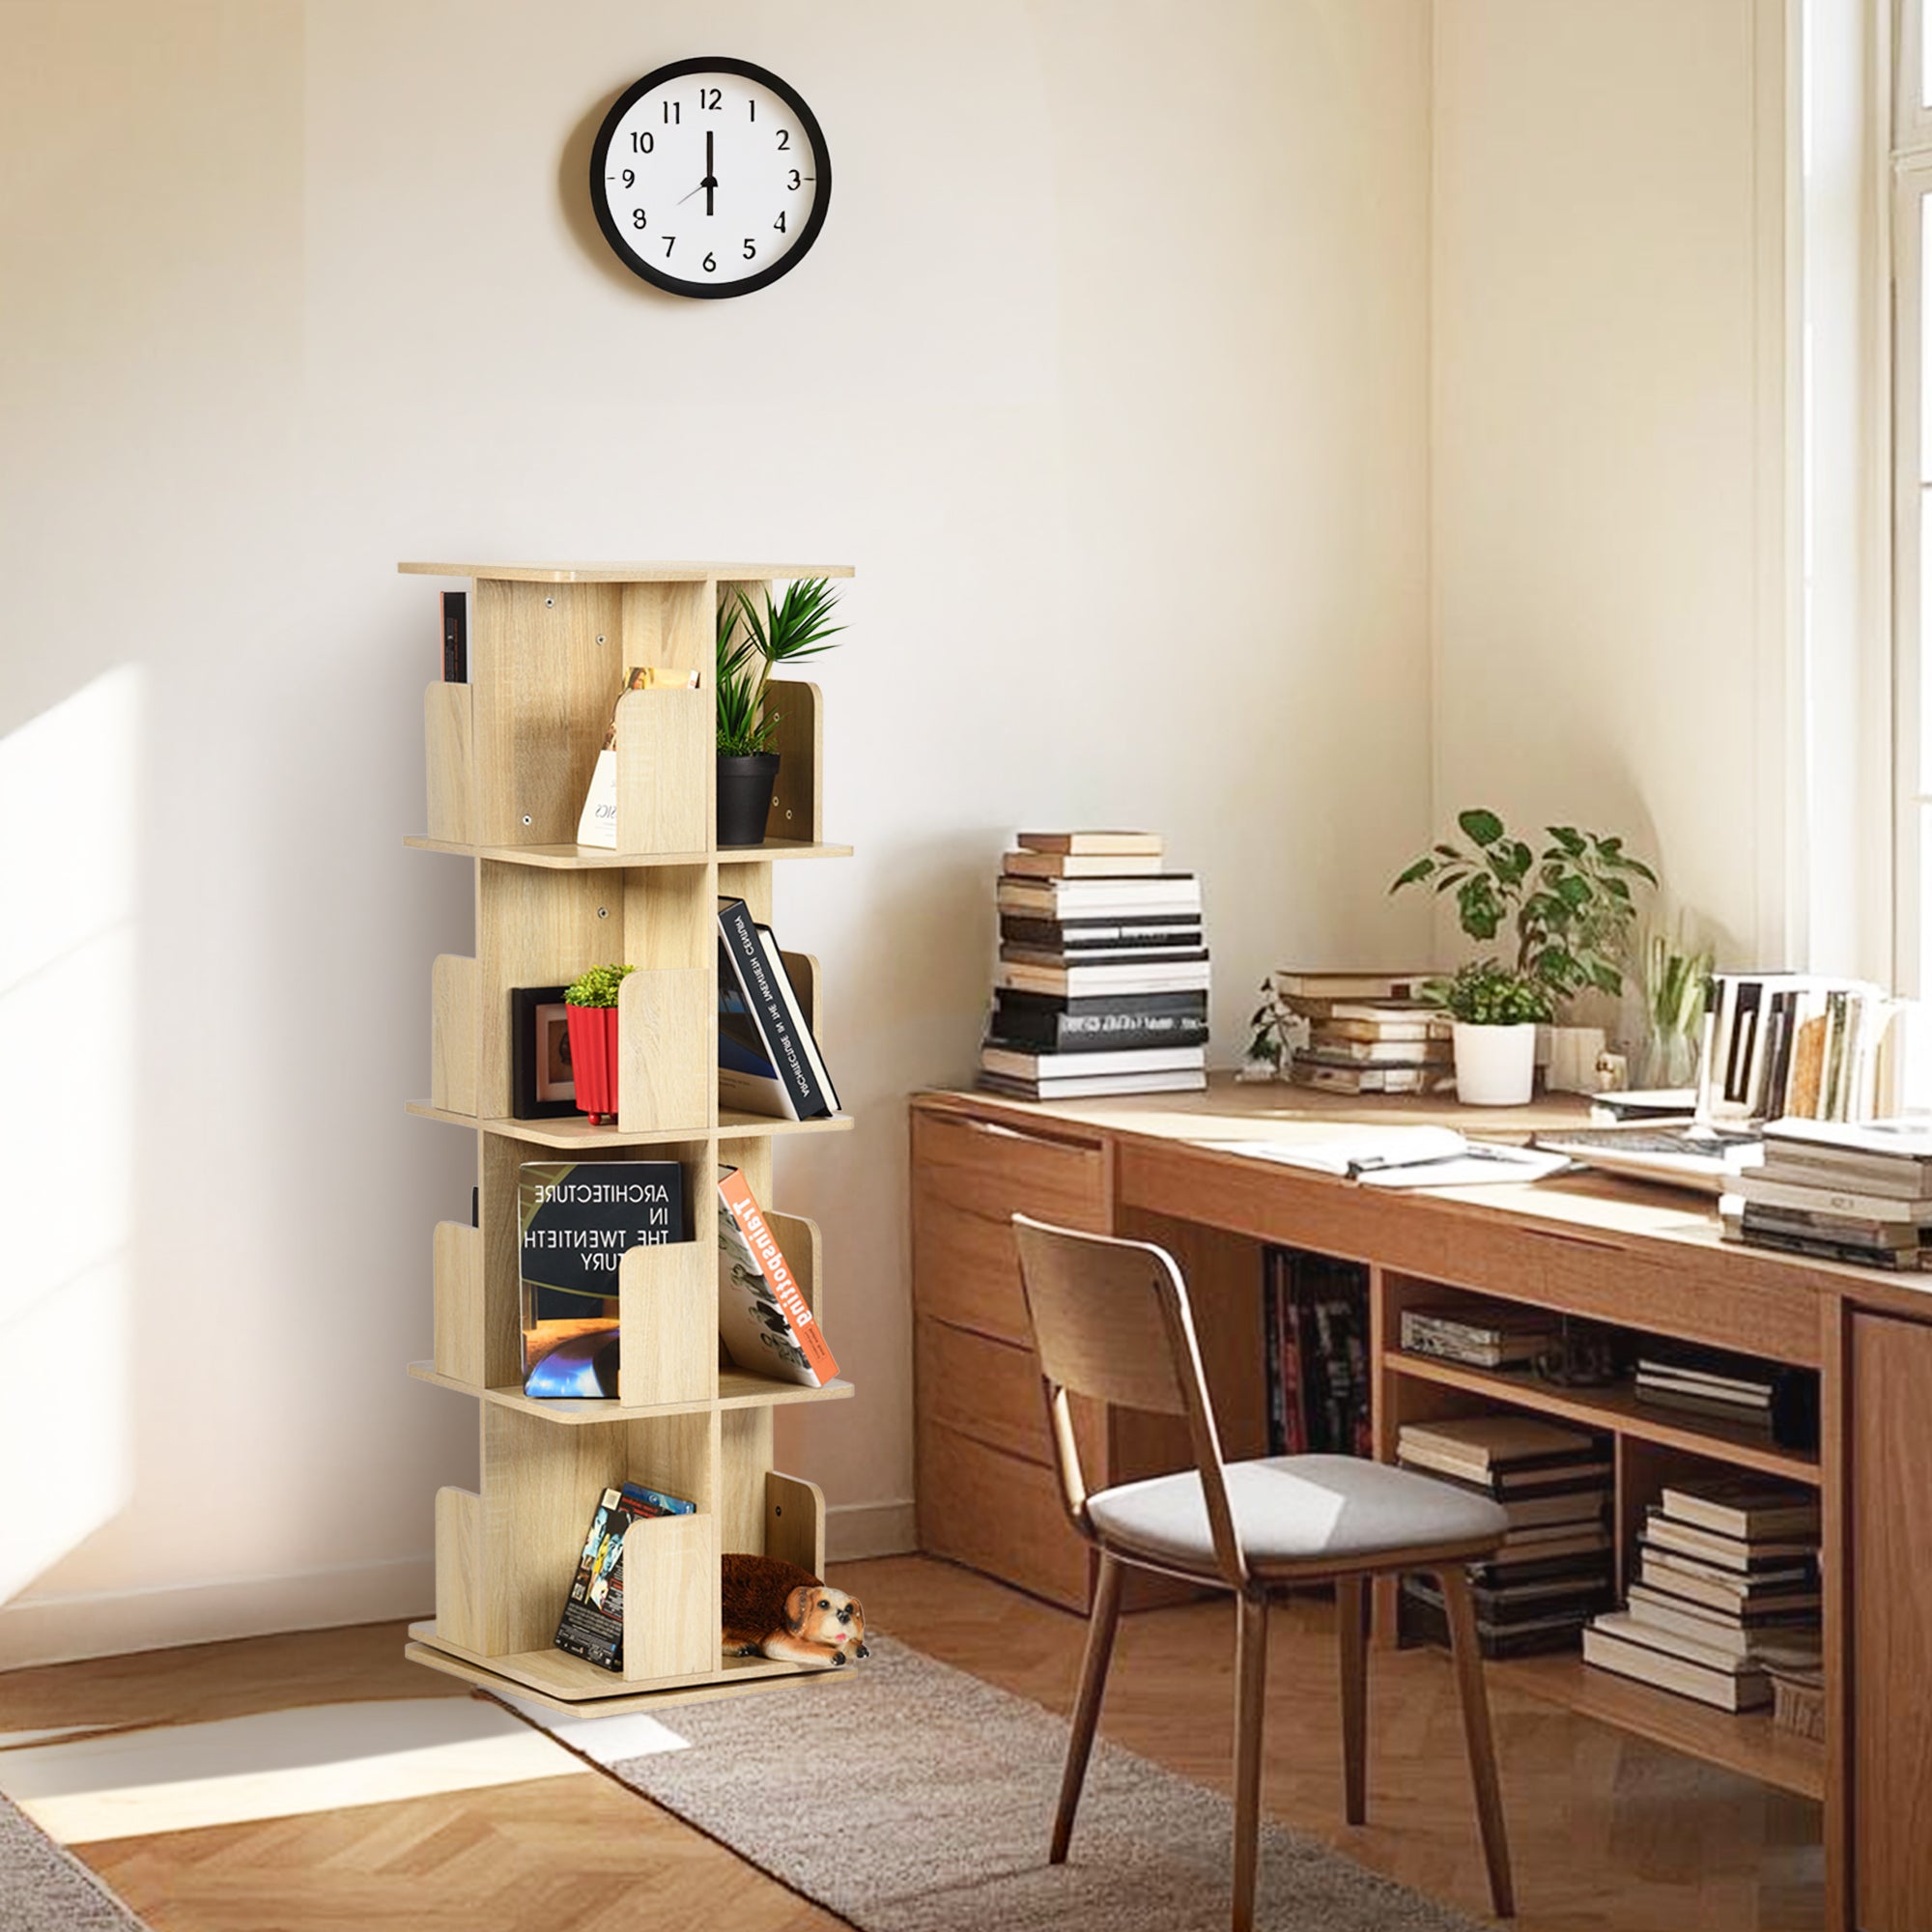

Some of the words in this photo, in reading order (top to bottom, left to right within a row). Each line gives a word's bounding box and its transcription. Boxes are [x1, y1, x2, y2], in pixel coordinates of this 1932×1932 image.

[700, 89, 722, 110] 12
[663, 100, 680, 125] 11
[749, 99, 755, 123] 1
[630, 131, 654, 154] 10
[776, 129, 790, 151] 2
[622, 168, 636, 188] 9
[787, 169, 801, 191] 3
[633, 208, 646, 229] 8
[774, 211, 786, 233] 4
[661, 236, 676, 258] 7
[743, 239, 756, 260] 5
[702, 251, 717, 272] 6
